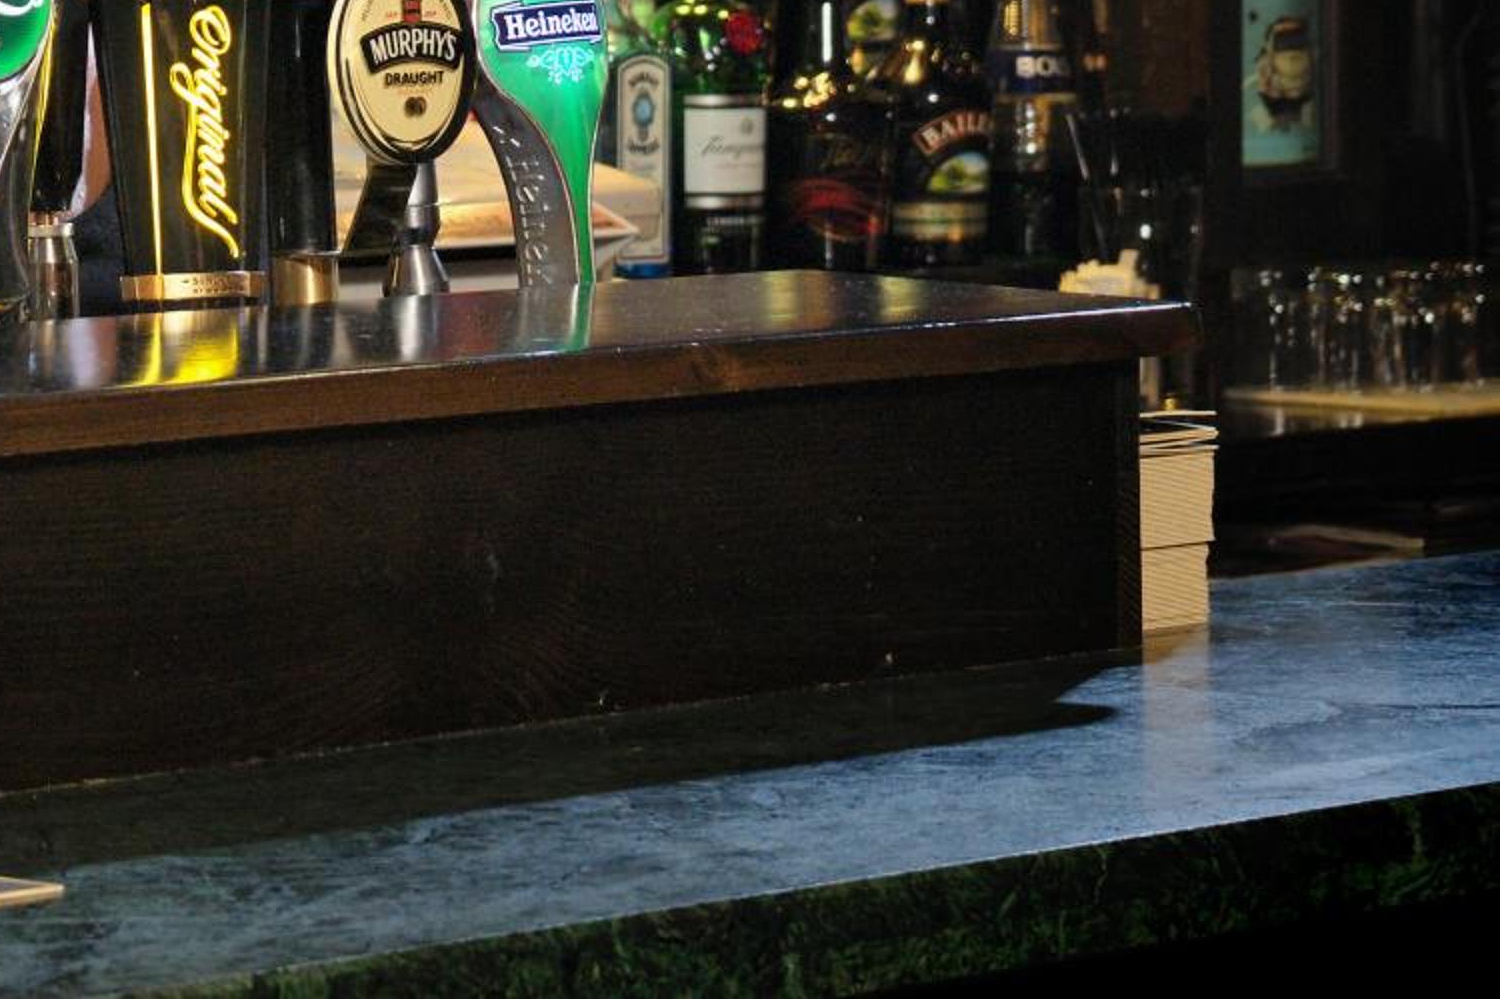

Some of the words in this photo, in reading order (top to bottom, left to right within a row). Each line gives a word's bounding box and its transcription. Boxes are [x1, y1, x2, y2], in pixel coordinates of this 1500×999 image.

[503, 8, 599, 42] Heineken
[369, 27, 458, 65] MURPHY'S
[384, 70, 445, 87] DRAUGHT
[169, 4, 240, 260] Original
